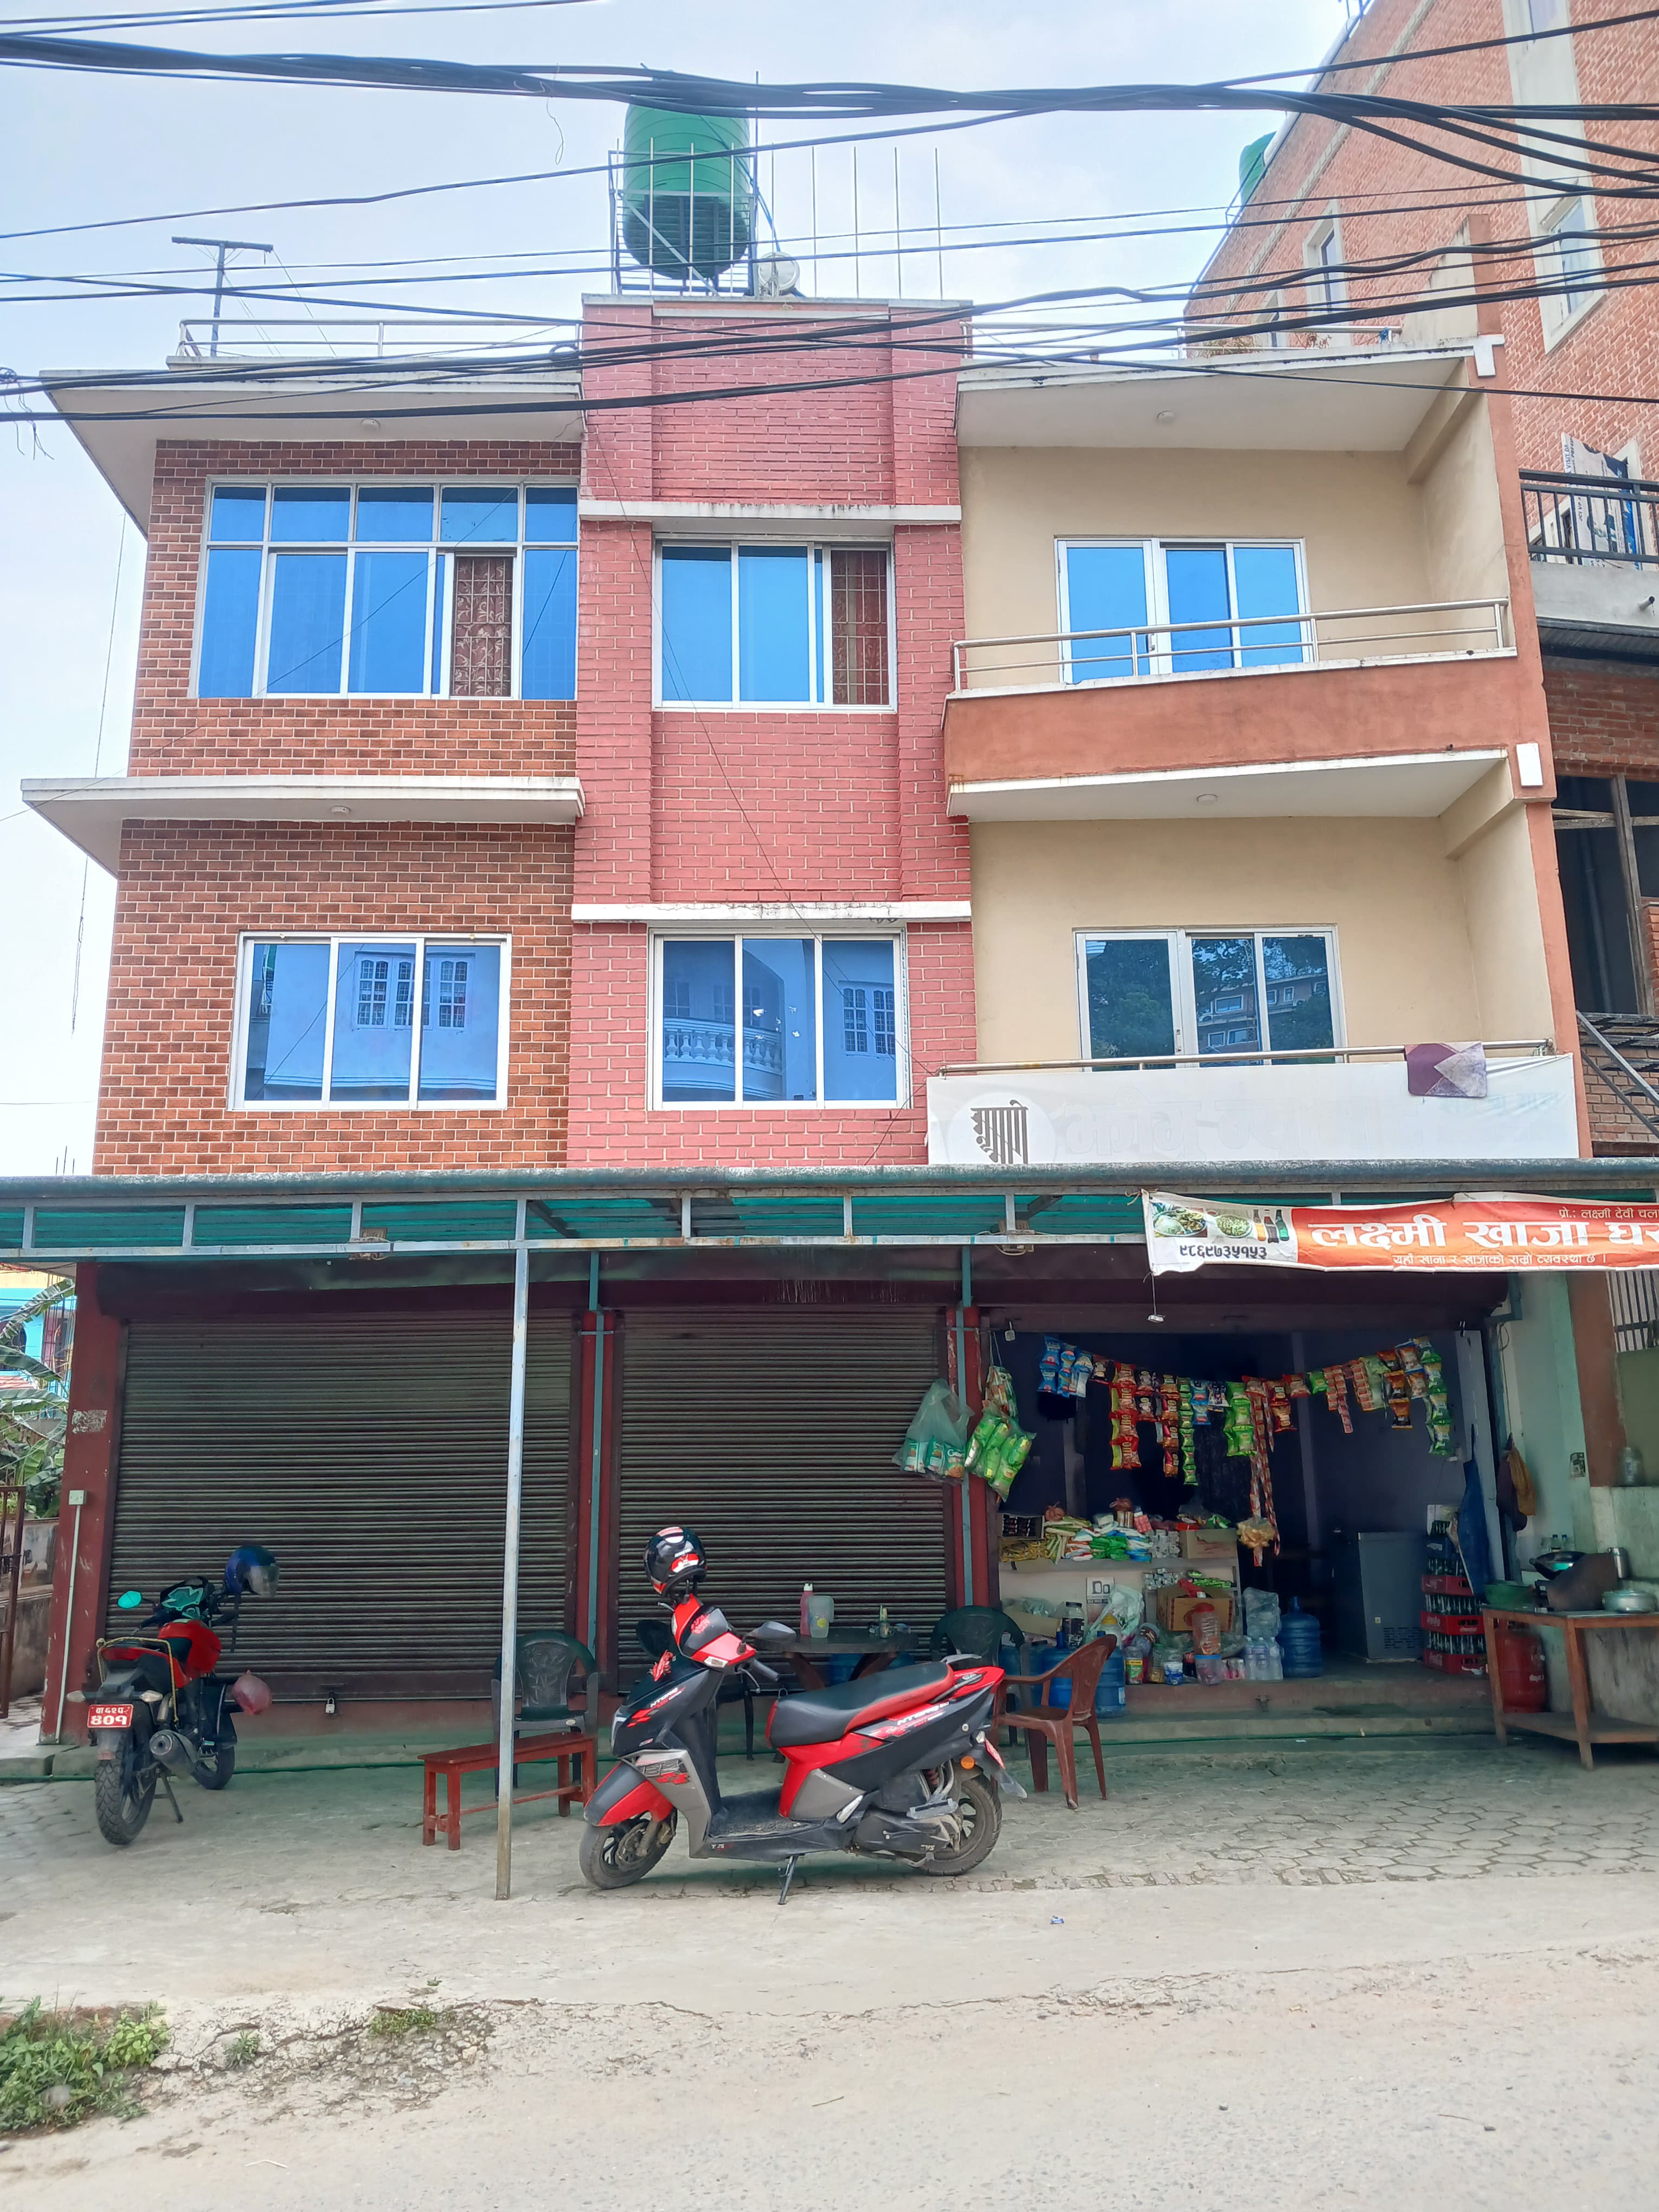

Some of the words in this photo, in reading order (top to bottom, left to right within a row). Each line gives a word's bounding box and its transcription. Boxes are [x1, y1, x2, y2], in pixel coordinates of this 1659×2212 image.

[1581, 1208, 1611, 1219] लक्ष्मी
[1615, 1207, 1634, 1220] देवी
[1308, 1214, 1447, 1250] लक्ष्मी
[1462, 1221, 1590, 1249] खाजा
[1417, 1255, 1446, 1264] खाना
[1449, 1255, 1458, 1264] र
[1461, 1252, 1504, 1265] खाजाको
[1536, 1254, 1583, 1264] व्यवस्था
[90, 1715, 127, 1726] ४०१
